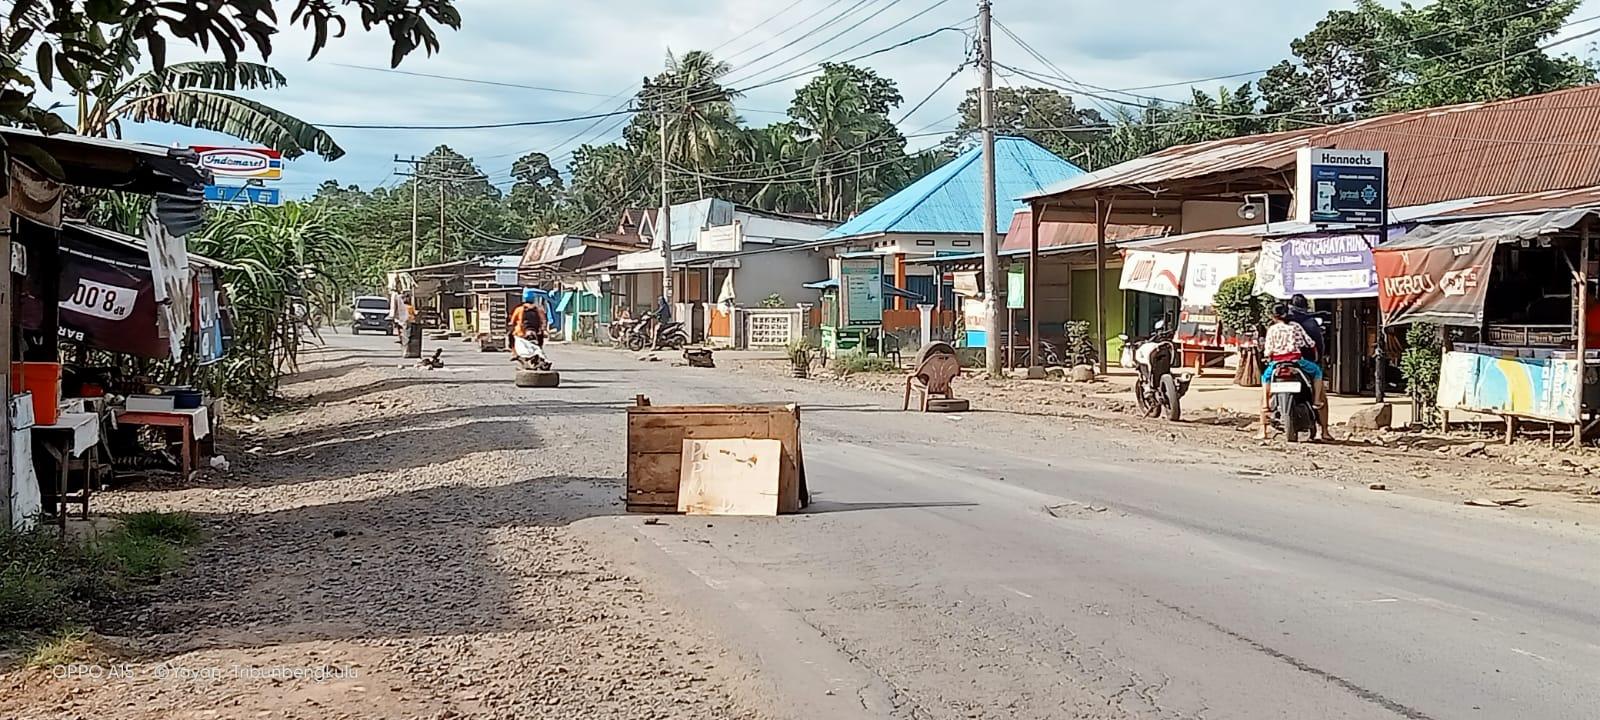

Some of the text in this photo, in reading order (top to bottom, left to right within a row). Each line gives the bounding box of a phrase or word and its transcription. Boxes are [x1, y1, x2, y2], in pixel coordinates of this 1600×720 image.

[205, 155, 263, 167] Indomaret
[1322, 152, 1372, 165] Hannochs
[1312, 236, 1346, 255] CAHAYA
